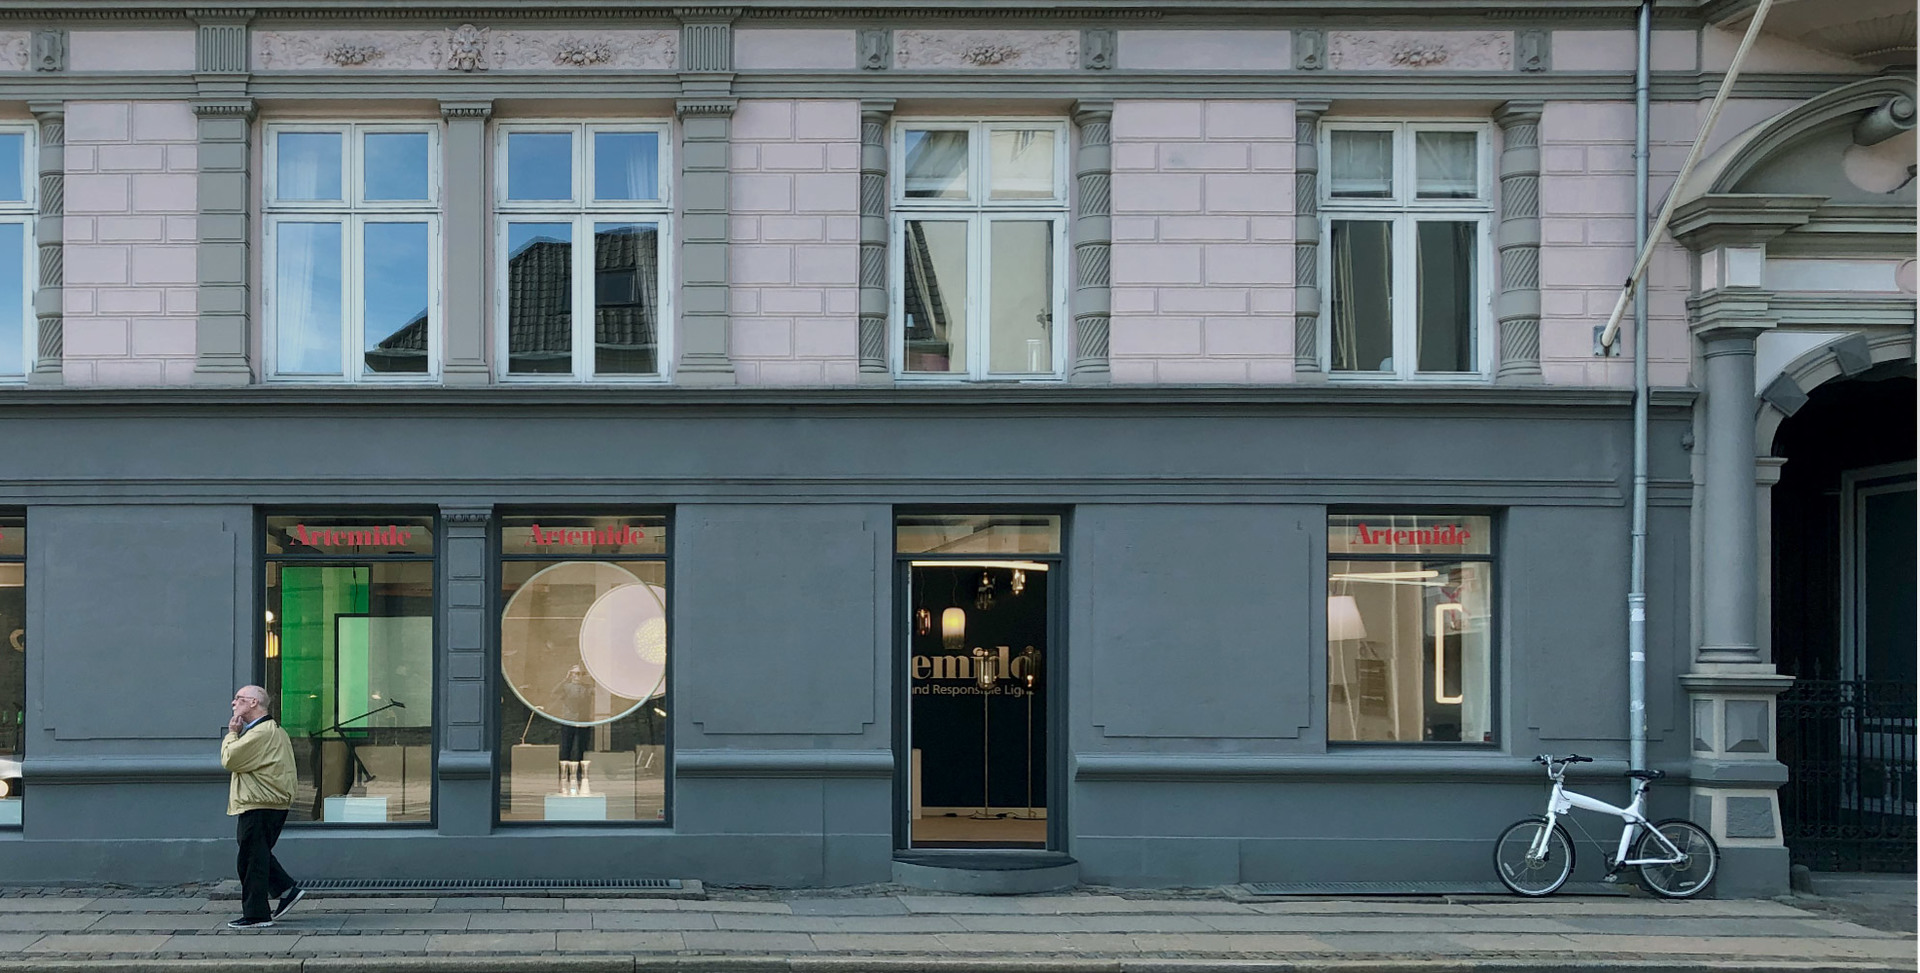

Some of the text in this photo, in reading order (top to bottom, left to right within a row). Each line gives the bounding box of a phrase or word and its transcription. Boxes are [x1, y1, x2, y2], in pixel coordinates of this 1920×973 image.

[289, 524, 412, 546] Artemide
[524, 524, 645, 546] Artemide
[1350, 523, 1471, 545] Artemide
